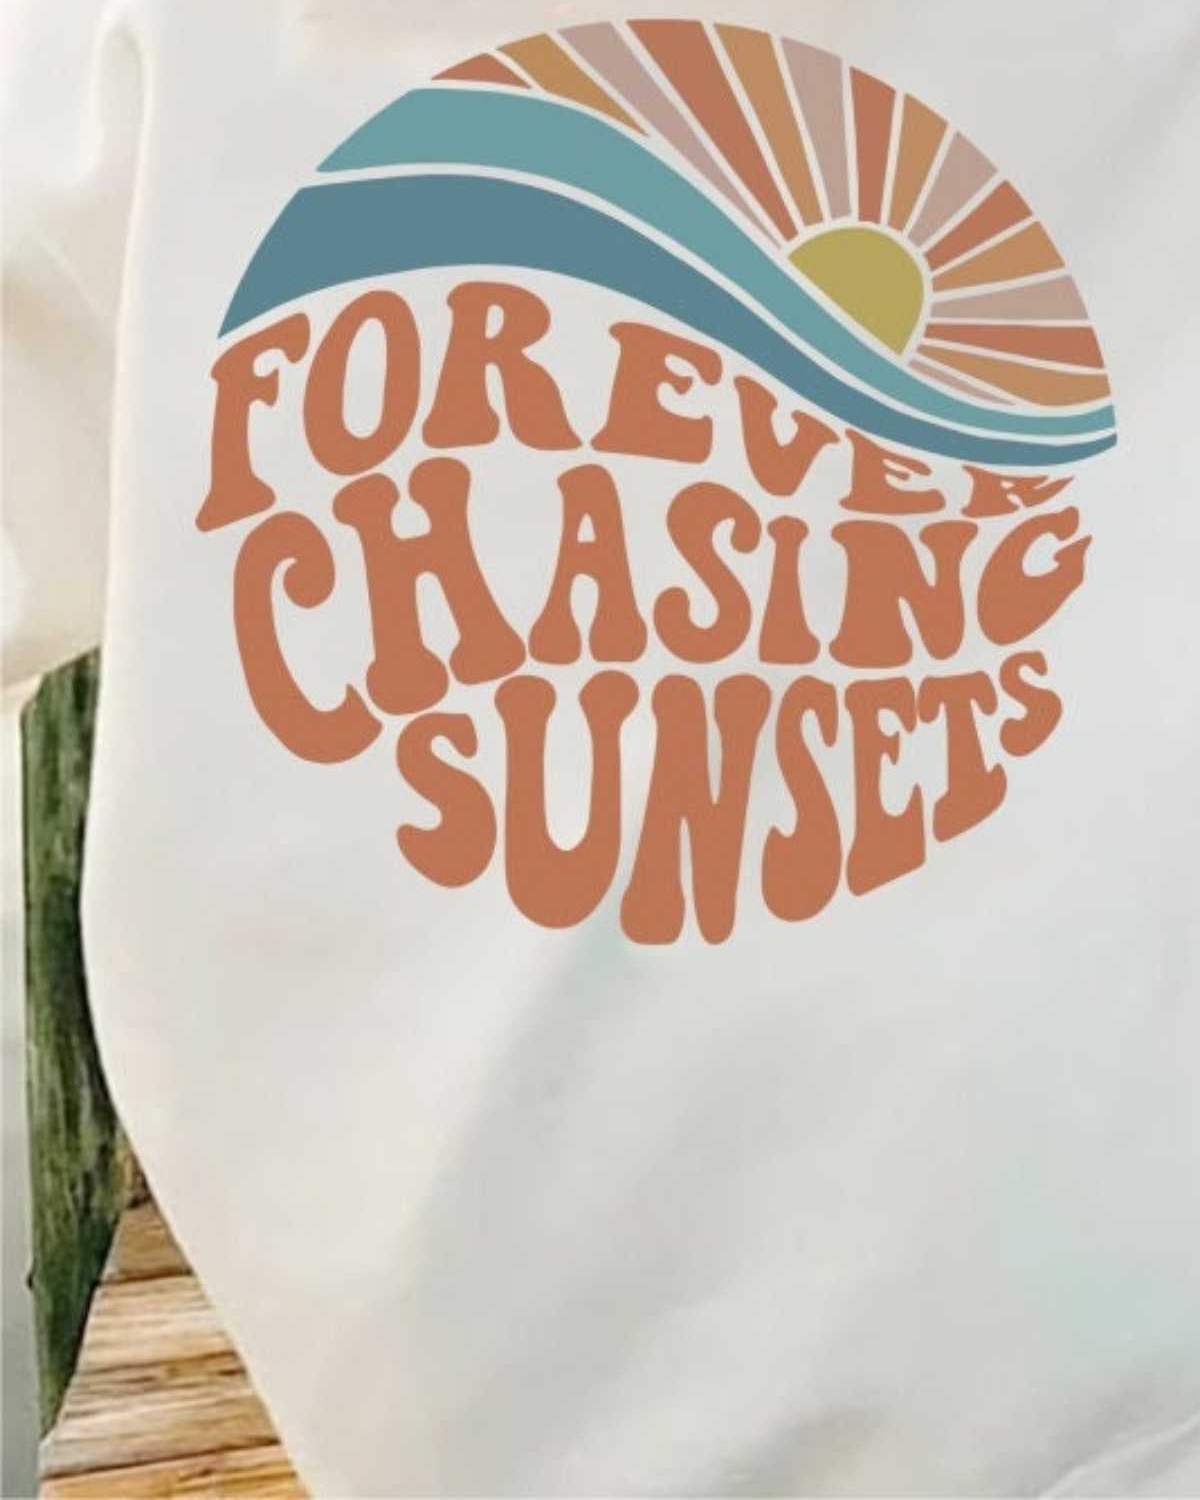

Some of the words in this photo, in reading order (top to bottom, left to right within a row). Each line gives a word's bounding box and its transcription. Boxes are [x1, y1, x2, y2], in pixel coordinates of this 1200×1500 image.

[196, 281, 1076, 532] FOREVER
[233, 457, 1092, 764] CHASING
[396, 651, 1062, 945] SUNSETS
